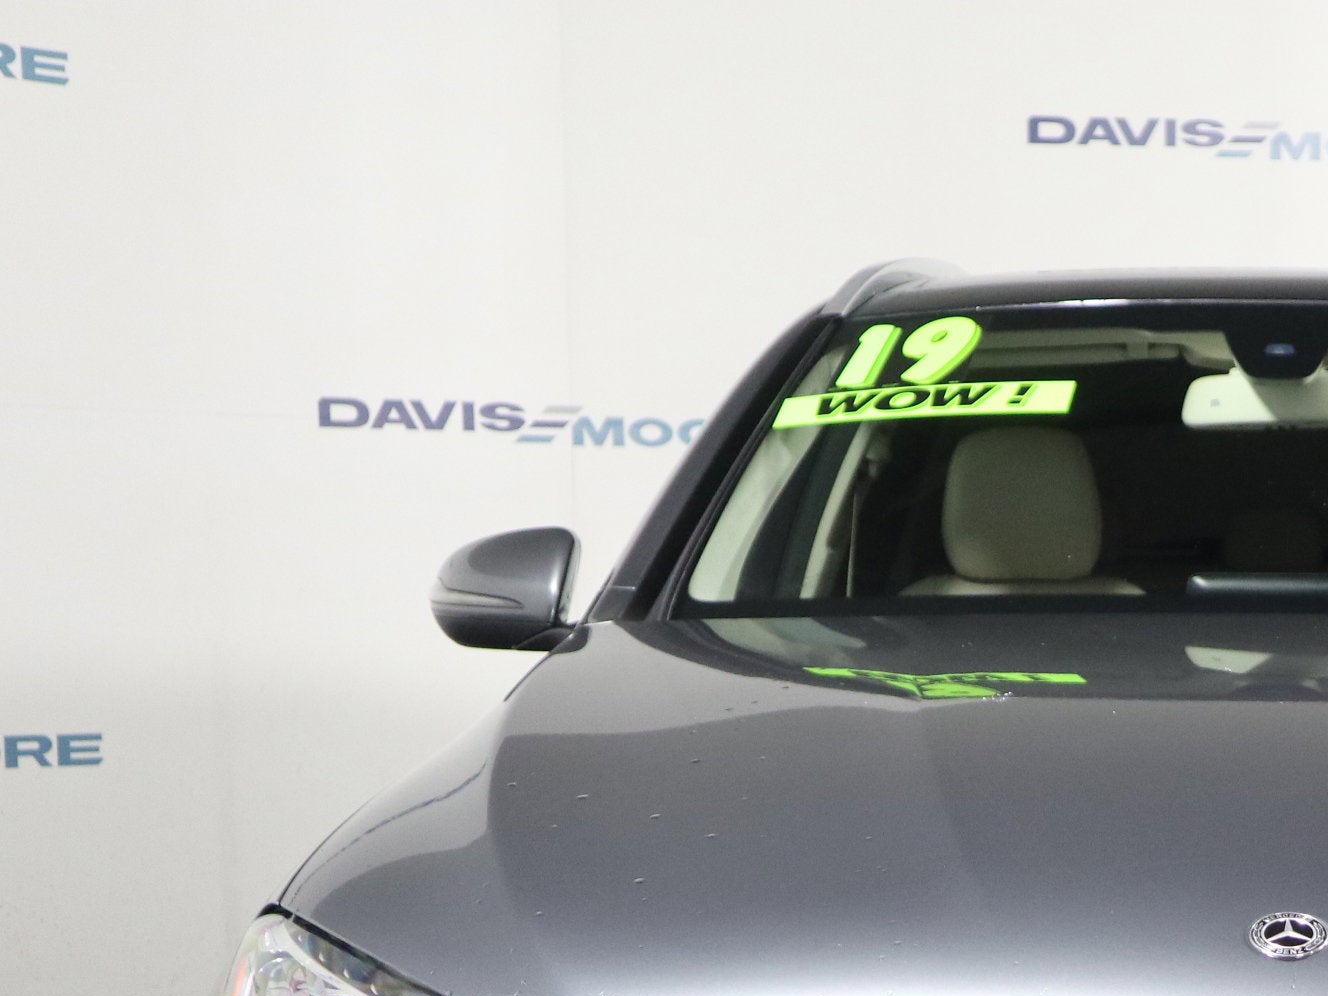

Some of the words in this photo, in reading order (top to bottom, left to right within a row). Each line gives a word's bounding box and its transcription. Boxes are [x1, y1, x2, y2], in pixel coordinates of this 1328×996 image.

[1027, 115, 1225, 147] DAVIS
[835, 316, 983, 389] 19
[317, 396, 526, 433] DAVIS
